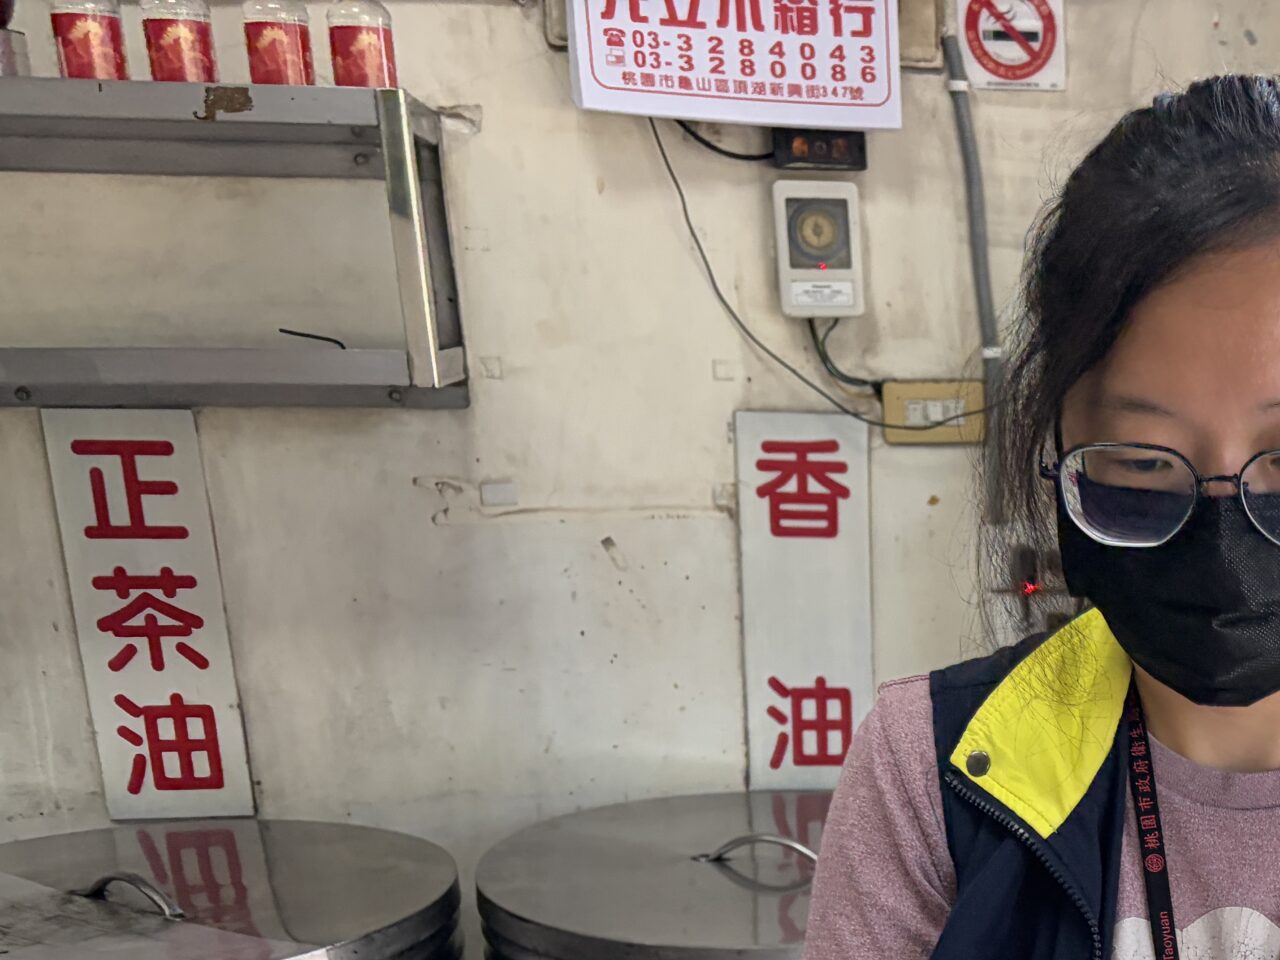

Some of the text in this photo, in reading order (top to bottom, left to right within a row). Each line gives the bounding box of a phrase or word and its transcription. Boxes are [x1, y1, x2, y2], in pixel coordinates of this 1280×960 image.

[69, 439, 225, 795] 正茶油
[755, 439, 853, 769] 香油
